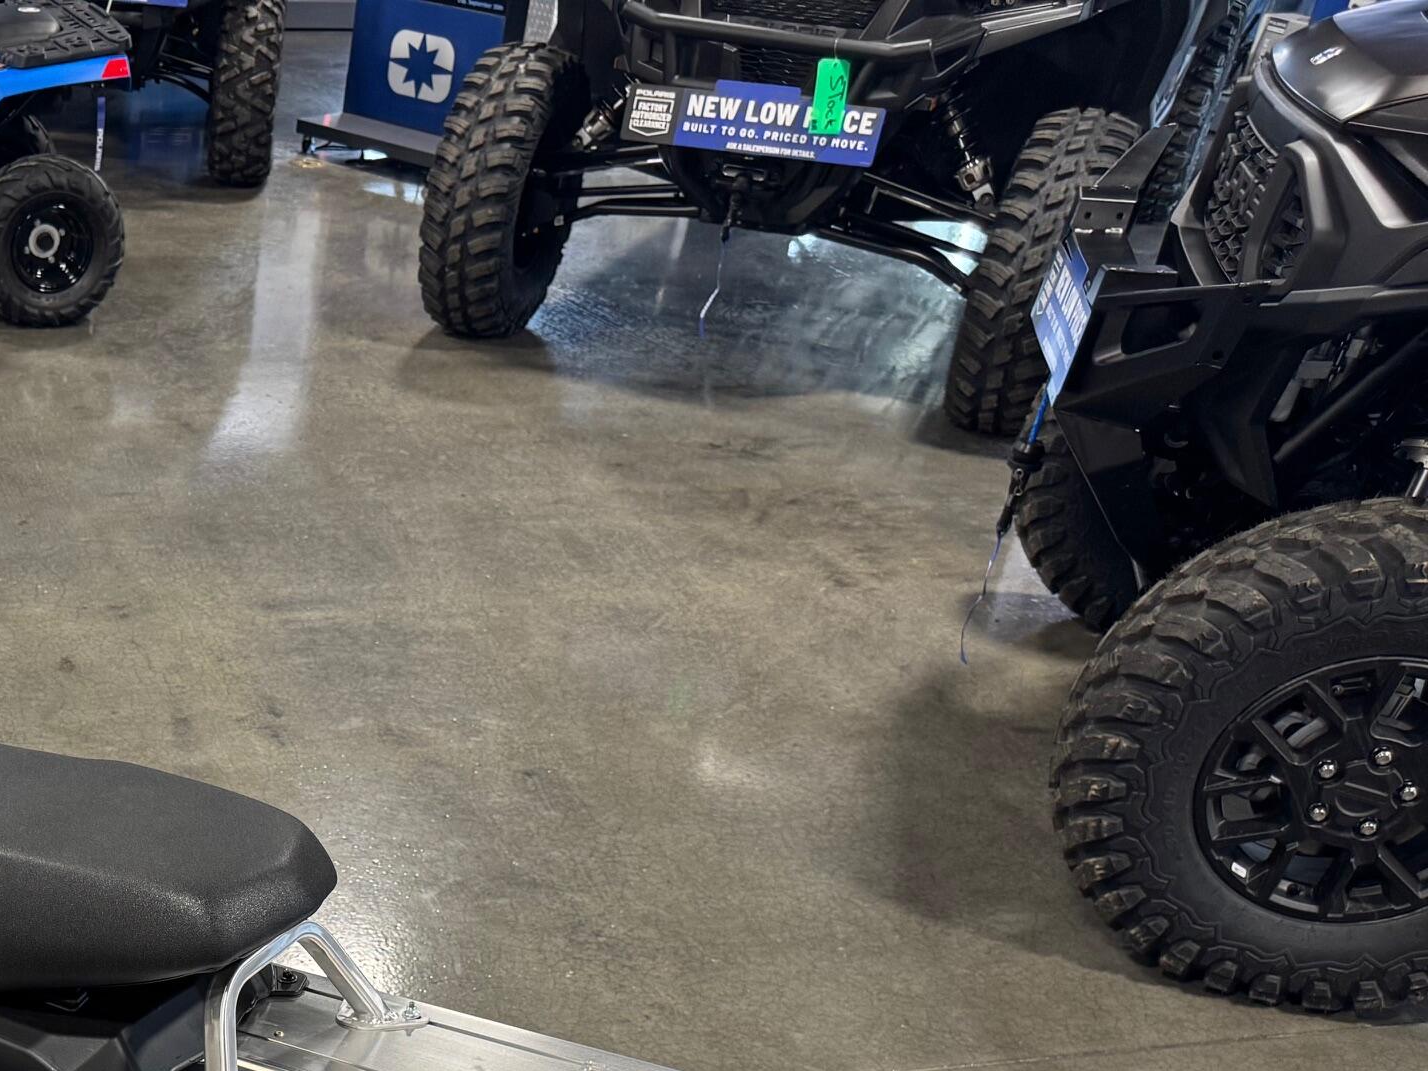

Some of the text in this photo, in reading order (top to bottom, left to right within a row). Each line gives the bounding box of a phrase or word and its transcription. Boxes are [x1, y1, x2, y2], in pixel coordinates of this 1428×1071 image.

[635, 88, 676, 99] POLARIS
[686, 94, 741, 121] NEW
[745, 100, 800, 128] LOW
[682, 121, 869, 152] BUILT TO GO. PRICED TO MOVE.
